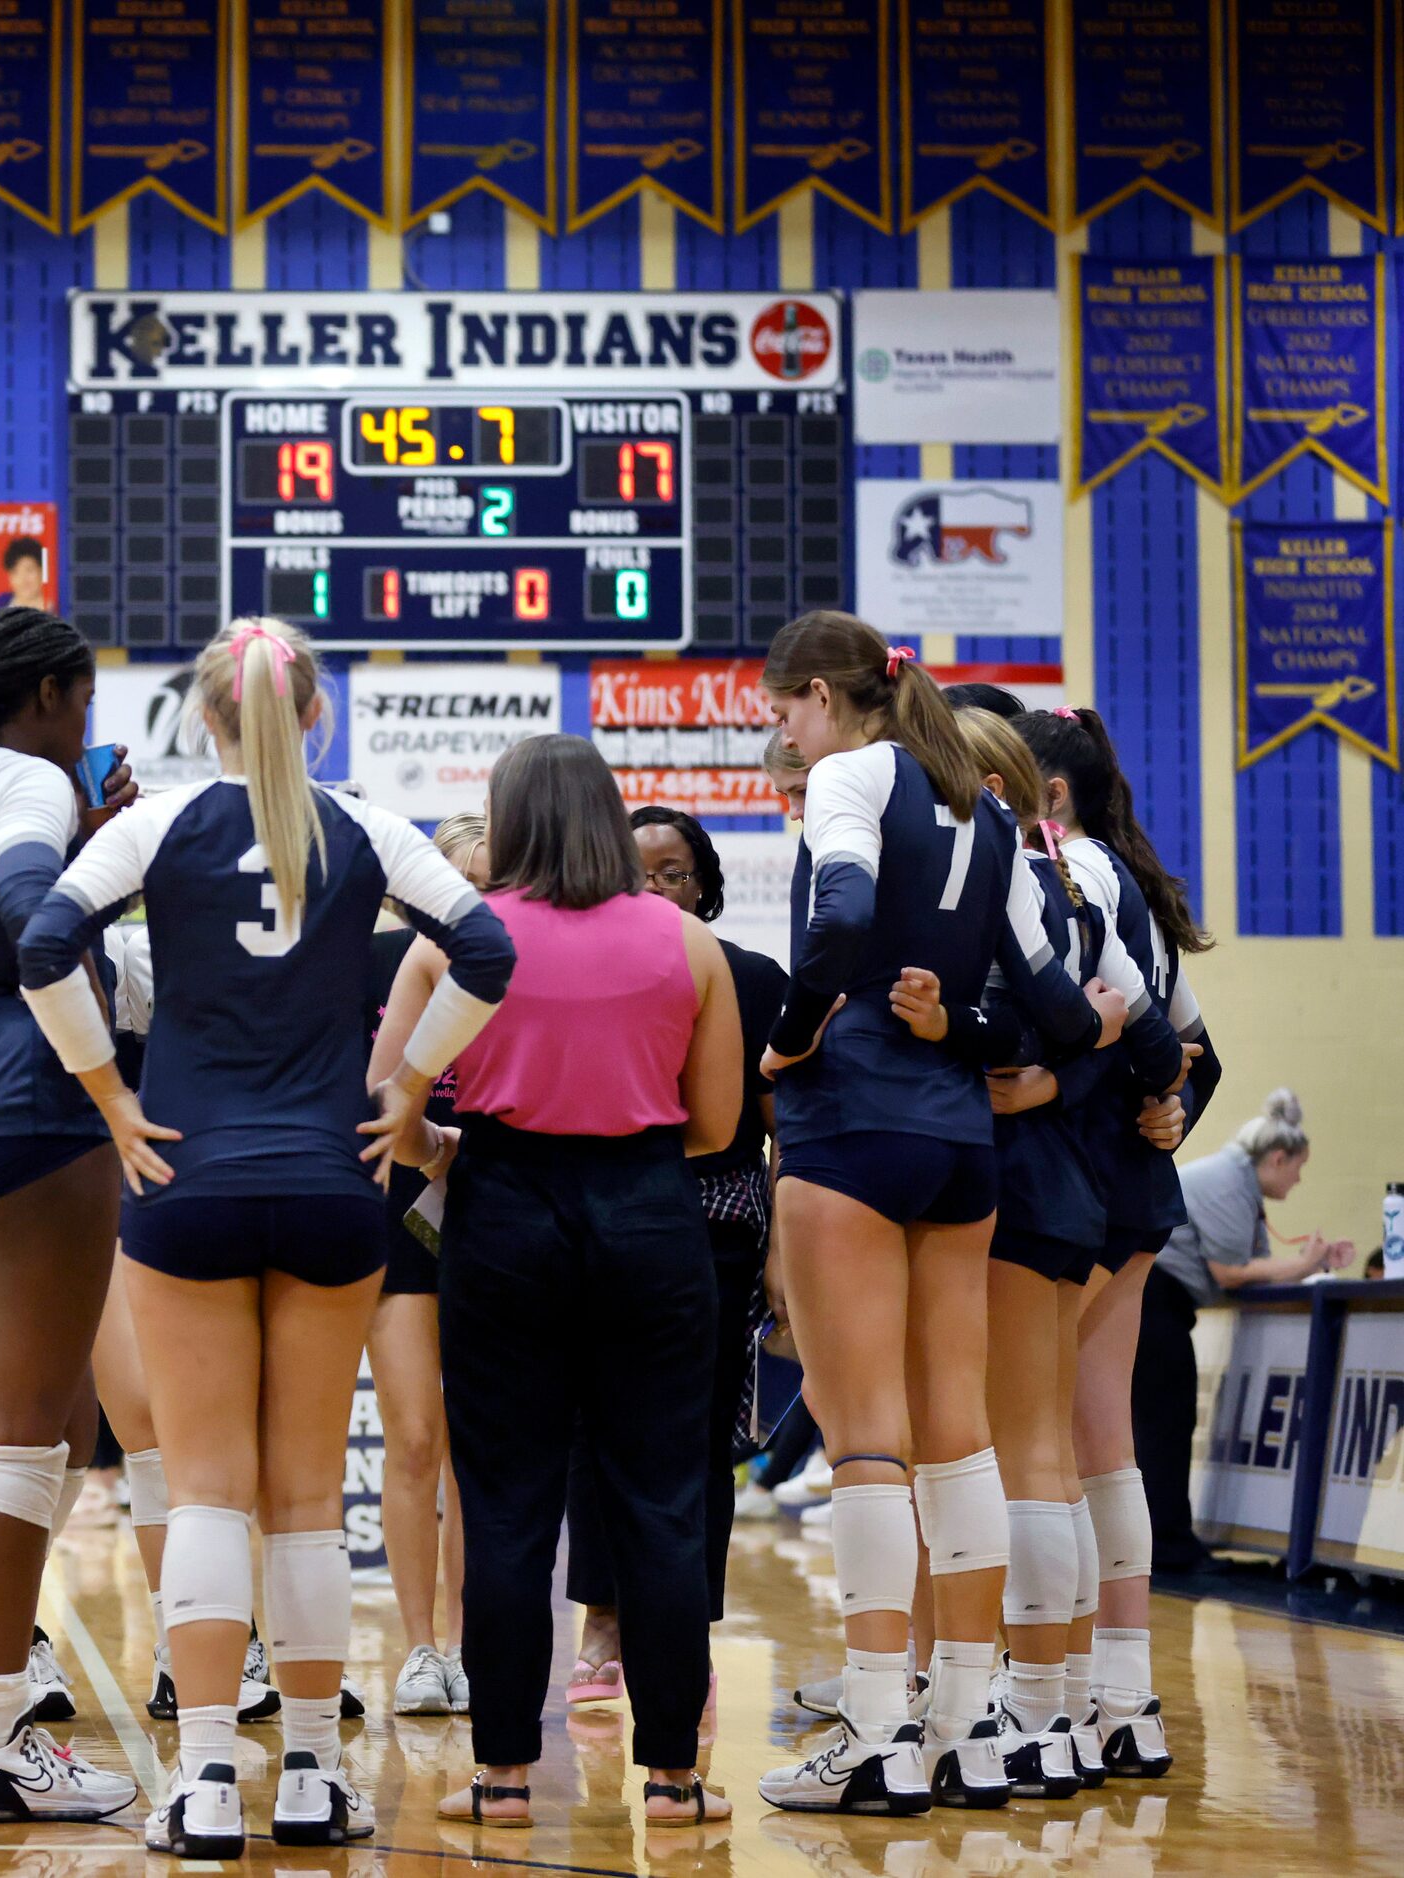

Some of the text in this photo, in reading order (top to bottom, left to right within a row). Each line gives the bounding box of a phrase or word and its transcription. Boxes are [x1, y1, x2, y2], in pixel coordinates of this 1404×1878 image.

[1113, 268, 1181, 283] KELLER
[1273, 266, 1342, 282] KELLER
[1089, 285, 1206, 301] HIGH SCHOOL
[1248, 284, 1368, 301] HIGH SCHOOL
[88, 302, 739, 379] KELLER INDIANS
[894, 347, 1015, 364] Texas Health
[1256, 355, 1357, 374] NATIONAL
[1104, 379, 1190, 397] CHAMPS
[1264, 378, 1351, 397] CHAMPS
[245, 404, 327, 433] HOME
[572, 403, 680, 434] VISITOR
[278, 442, 333, 501] 19
[618, 442, 673, 501] 17
[397, 496, 475, 519] PERIOD
[481, 486, 514, 536] 2
[275, 511, 342, 534] BONUS
[570, 511, 638, 534] BONUS
[1278, 539, 1347, 555] KELLER
[265, 549, 329, 570] FOULS
[586, 549, 650, 570] FOULS
[1254, 559, 1375, 576] HIGH SCHOOL
[313, 571, 327, 619] 1
[383, 569, 398, 619] 1
[406, 571, 508, 596] TIMEOUTS
[516, 568, 549, 619] 0
[431, 596, 482, 618] LEFT
[615, 571, 648, 620] 0
[1260, 626, 1368, 645] NATIONAL
[1272, 652, 1357, 671] CHAMPS
[593, 658, 779, 725] Kims Klose
[374, 692, 552, 718] FREEMAN
[934, 804, 976, 912] 7
[236, 845, 302, 957] 3
